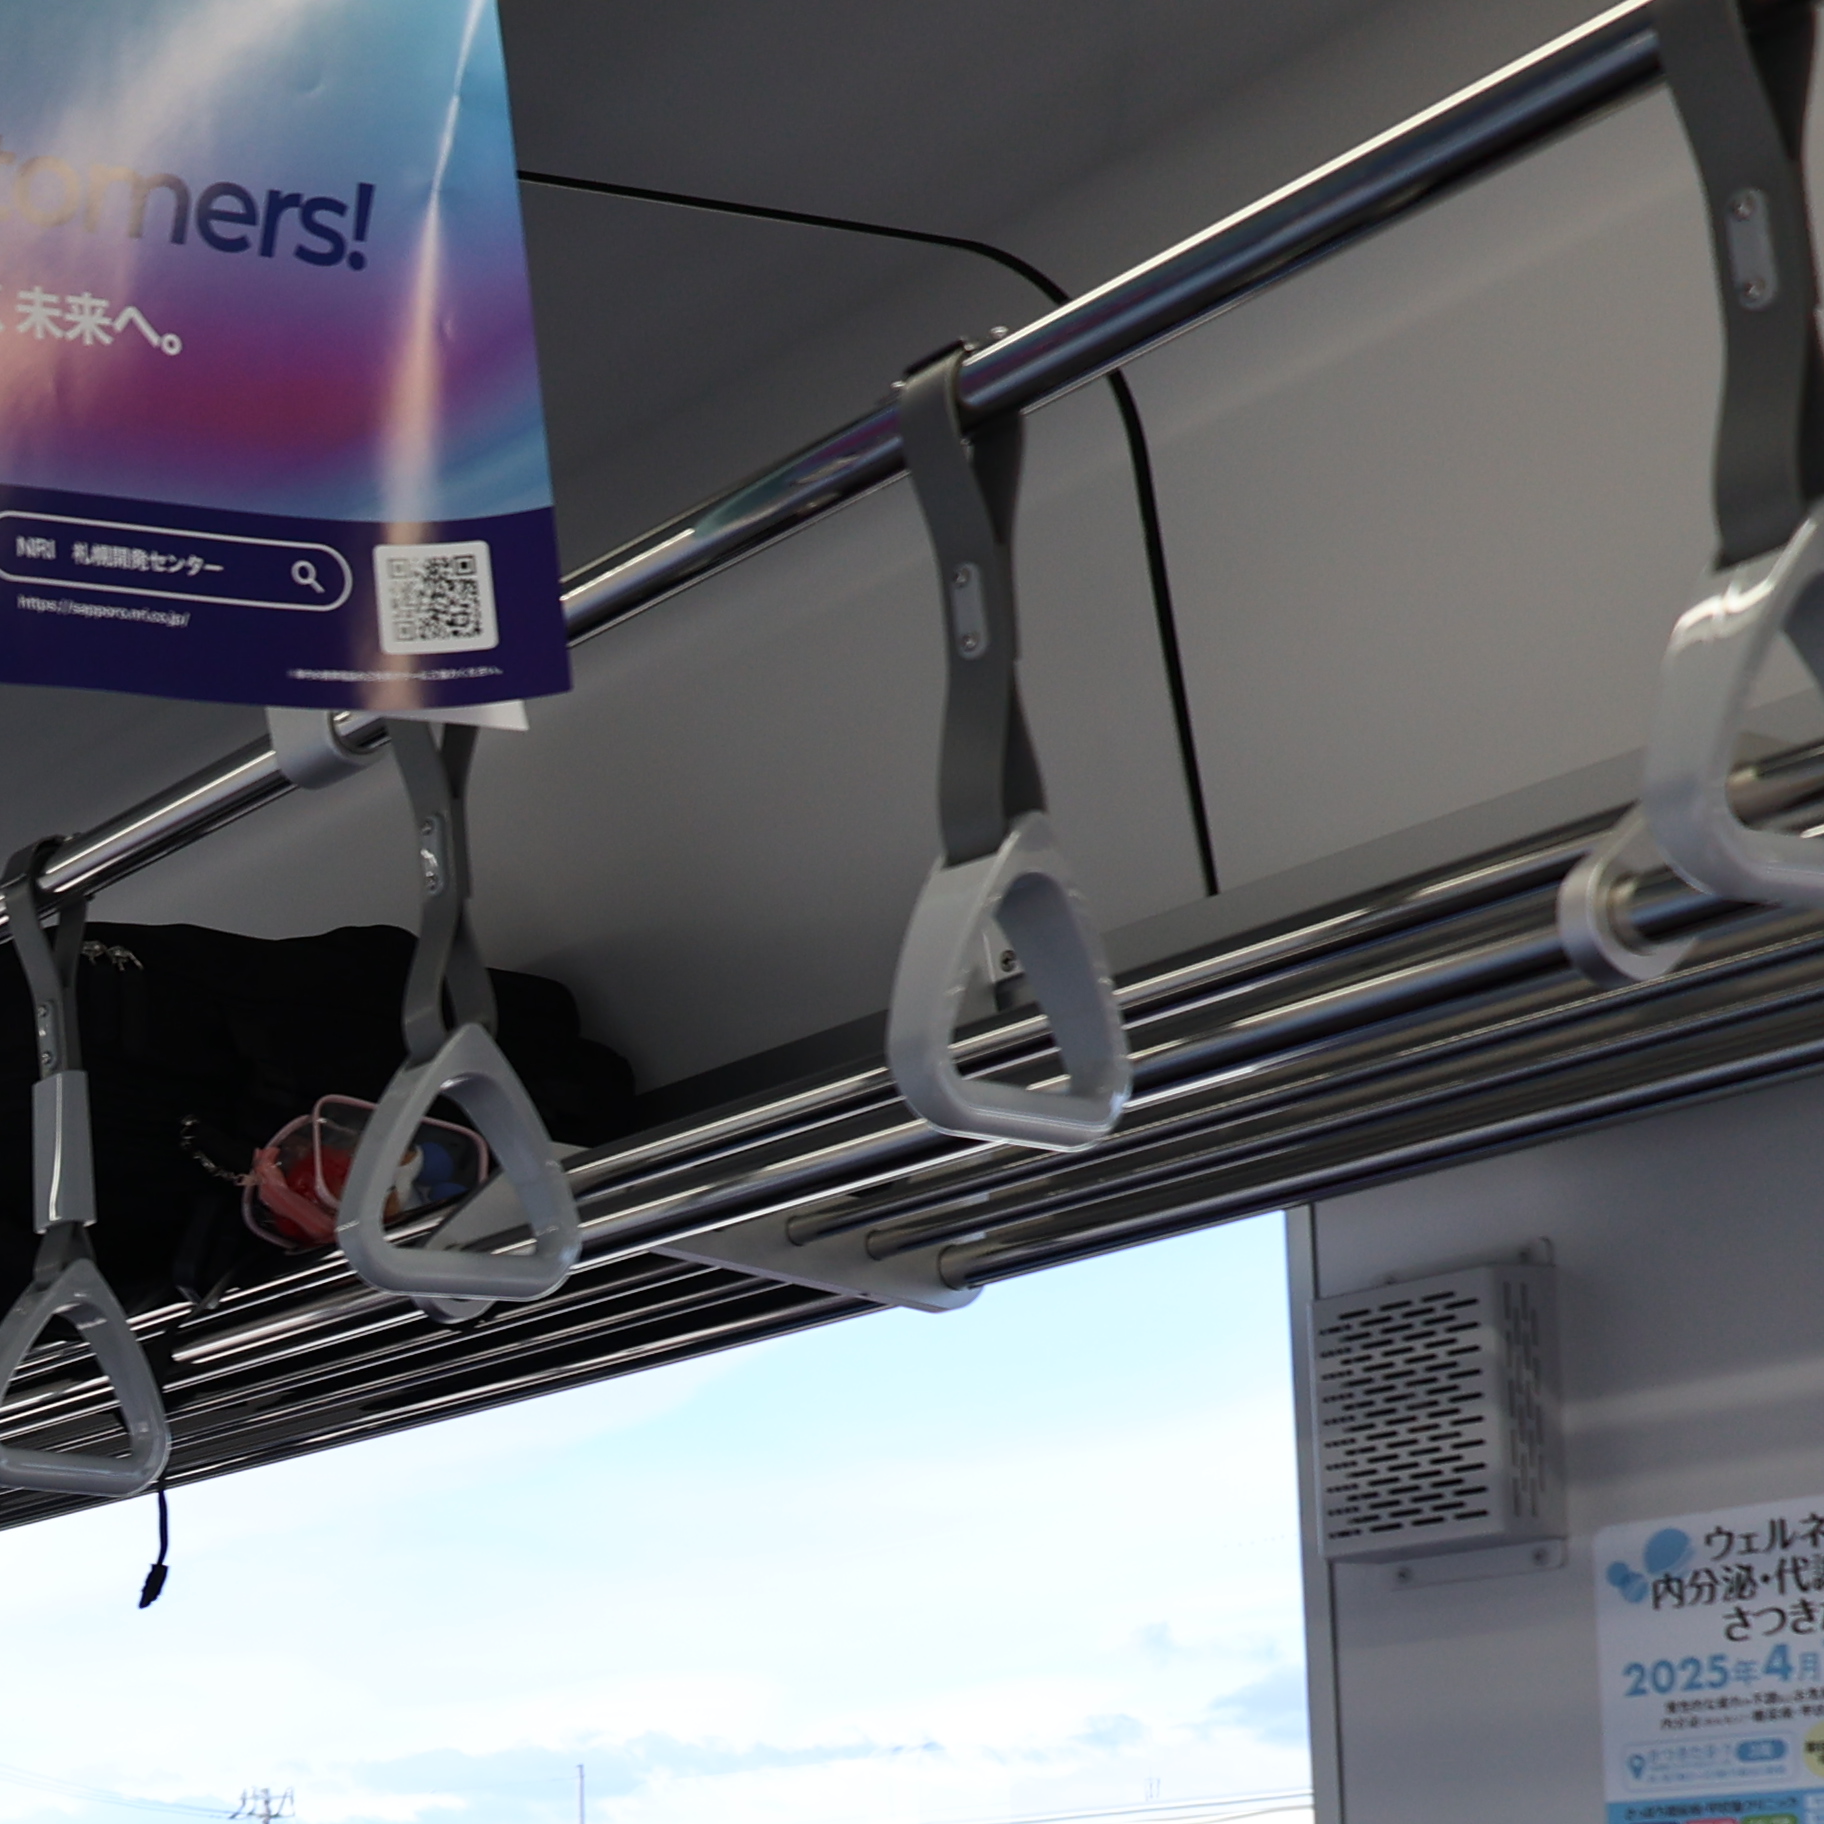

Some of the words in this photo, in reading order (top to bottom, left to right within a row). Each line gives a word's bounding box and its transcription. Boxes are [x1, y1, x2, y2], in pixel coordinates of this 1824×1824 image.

[16, 535, 56, 560] NRI
[1723, 1597, 1824, 1642] さつき
